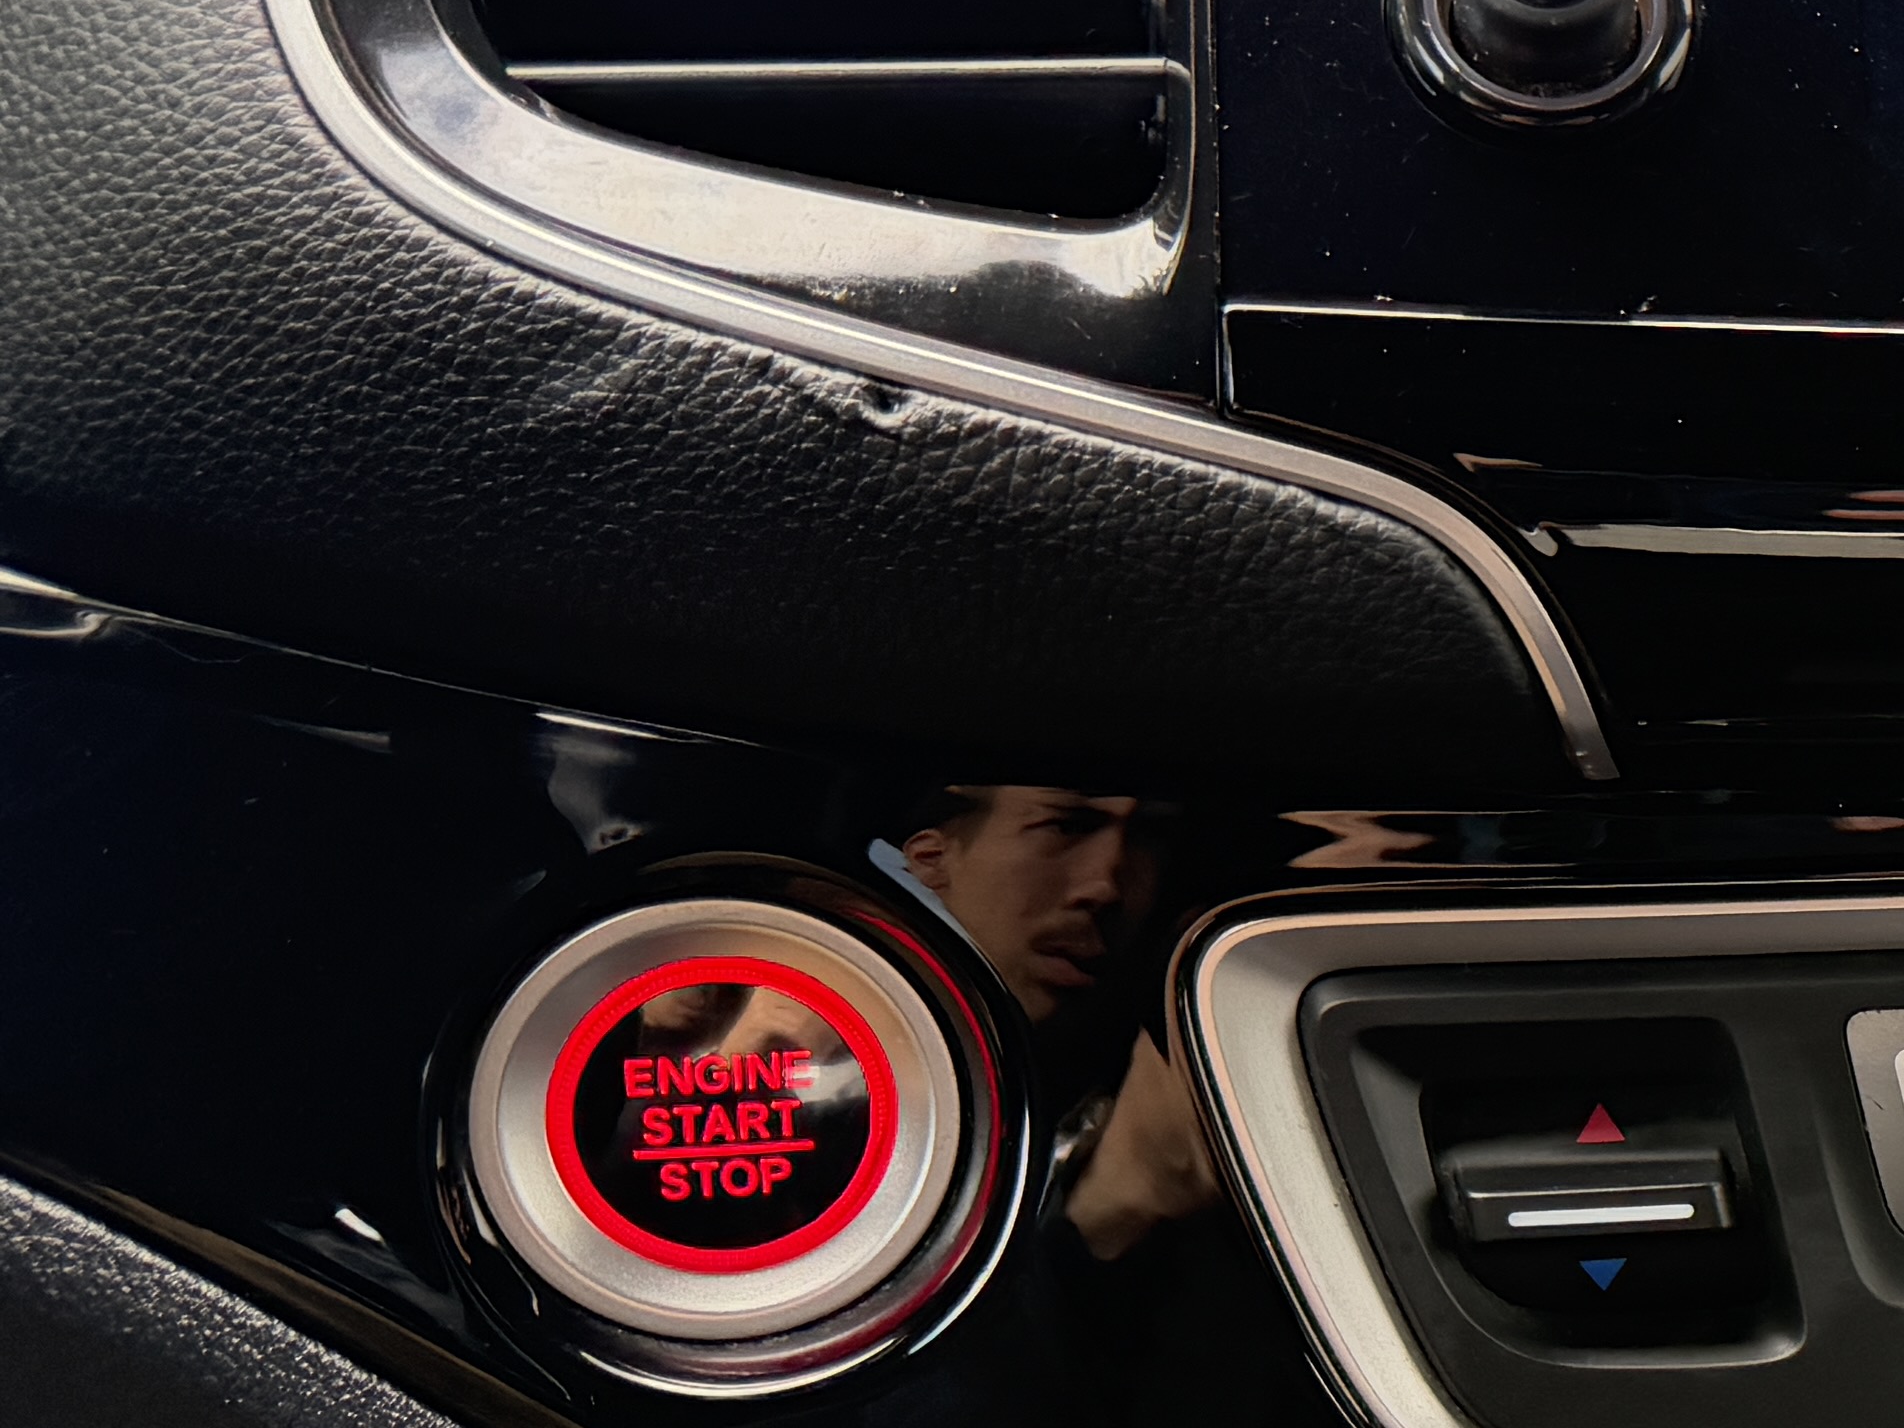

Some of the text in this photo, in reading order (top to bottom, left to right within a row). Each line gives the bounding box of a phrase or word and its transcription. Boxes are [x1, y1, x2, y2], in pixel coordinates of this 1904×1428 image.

[622, 1049, 815, 1099] ENGINE
[642, 1098, 803, 1147] START
[659, 1157, 794, 1202] STOP
